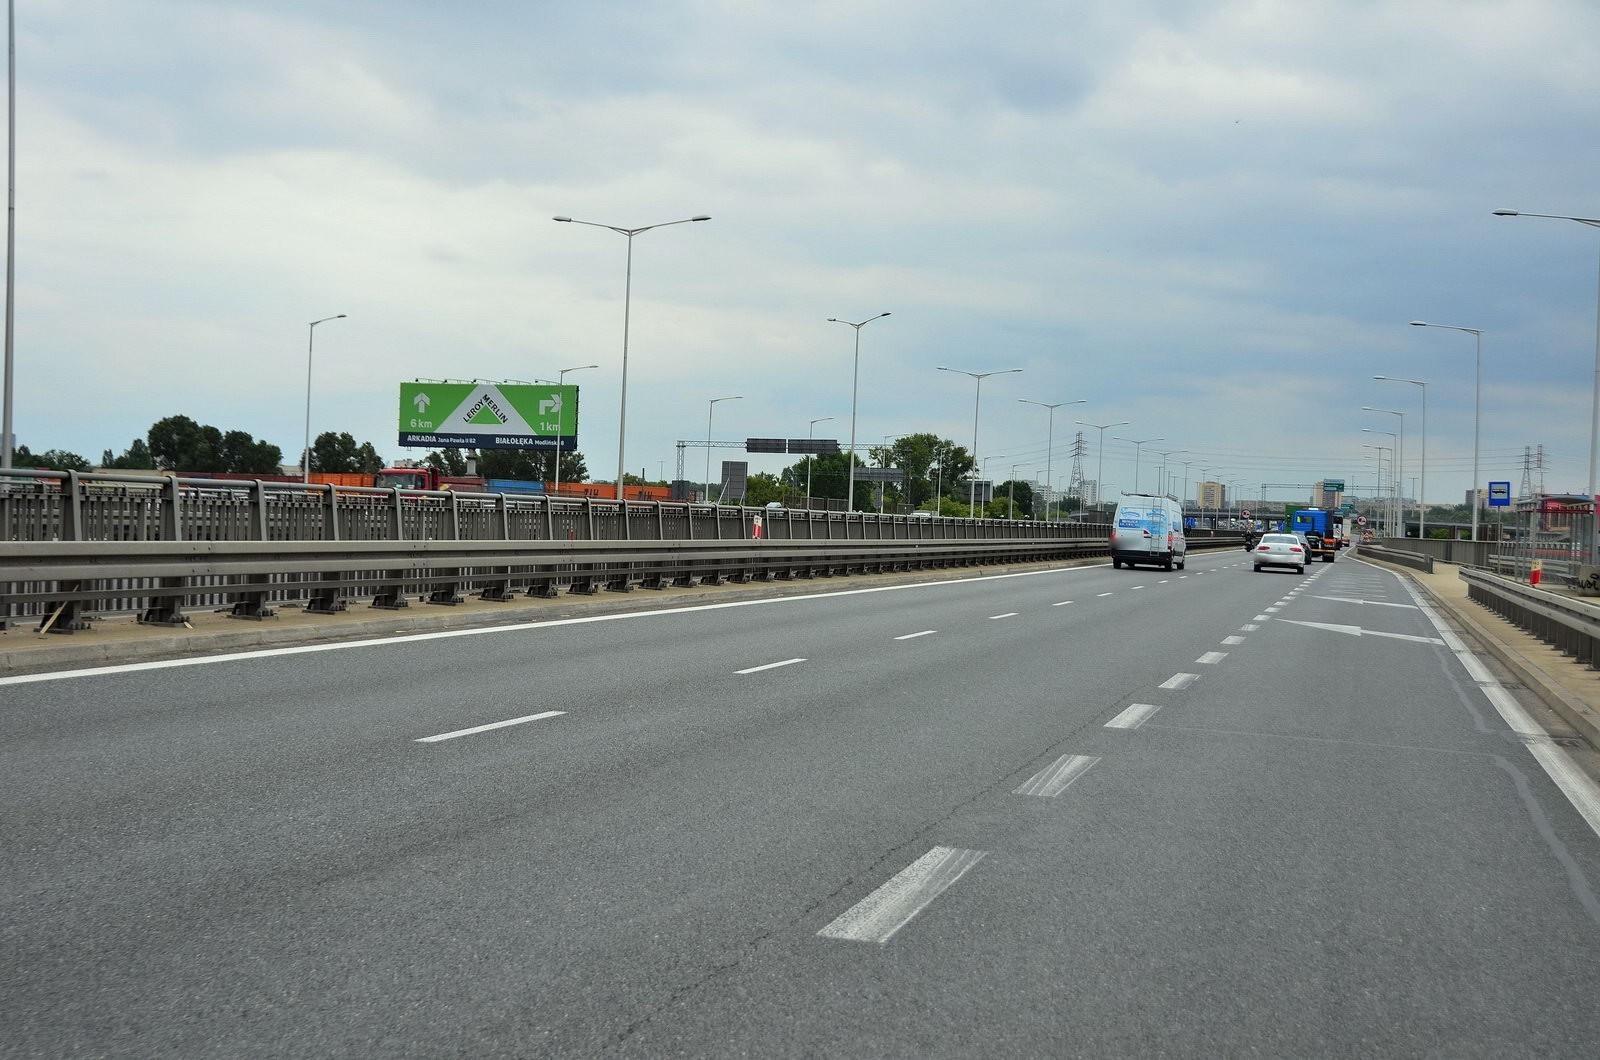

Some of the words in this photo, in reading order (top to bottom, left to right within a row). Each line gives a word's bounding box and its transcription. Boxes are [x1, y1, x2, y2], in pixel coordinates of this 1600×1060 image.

[462, 399, 484, 423] LEROY
[482, 394, 509, 424] MERLIN
[410, 418, 417, 428] 6
[418, 418, 433, 429] km
[539, 421, 545, 431] 1
[406, 434, 437, 442] ARKADIA
[495, 437, 533, 446] BIAŁOŁĘKA
